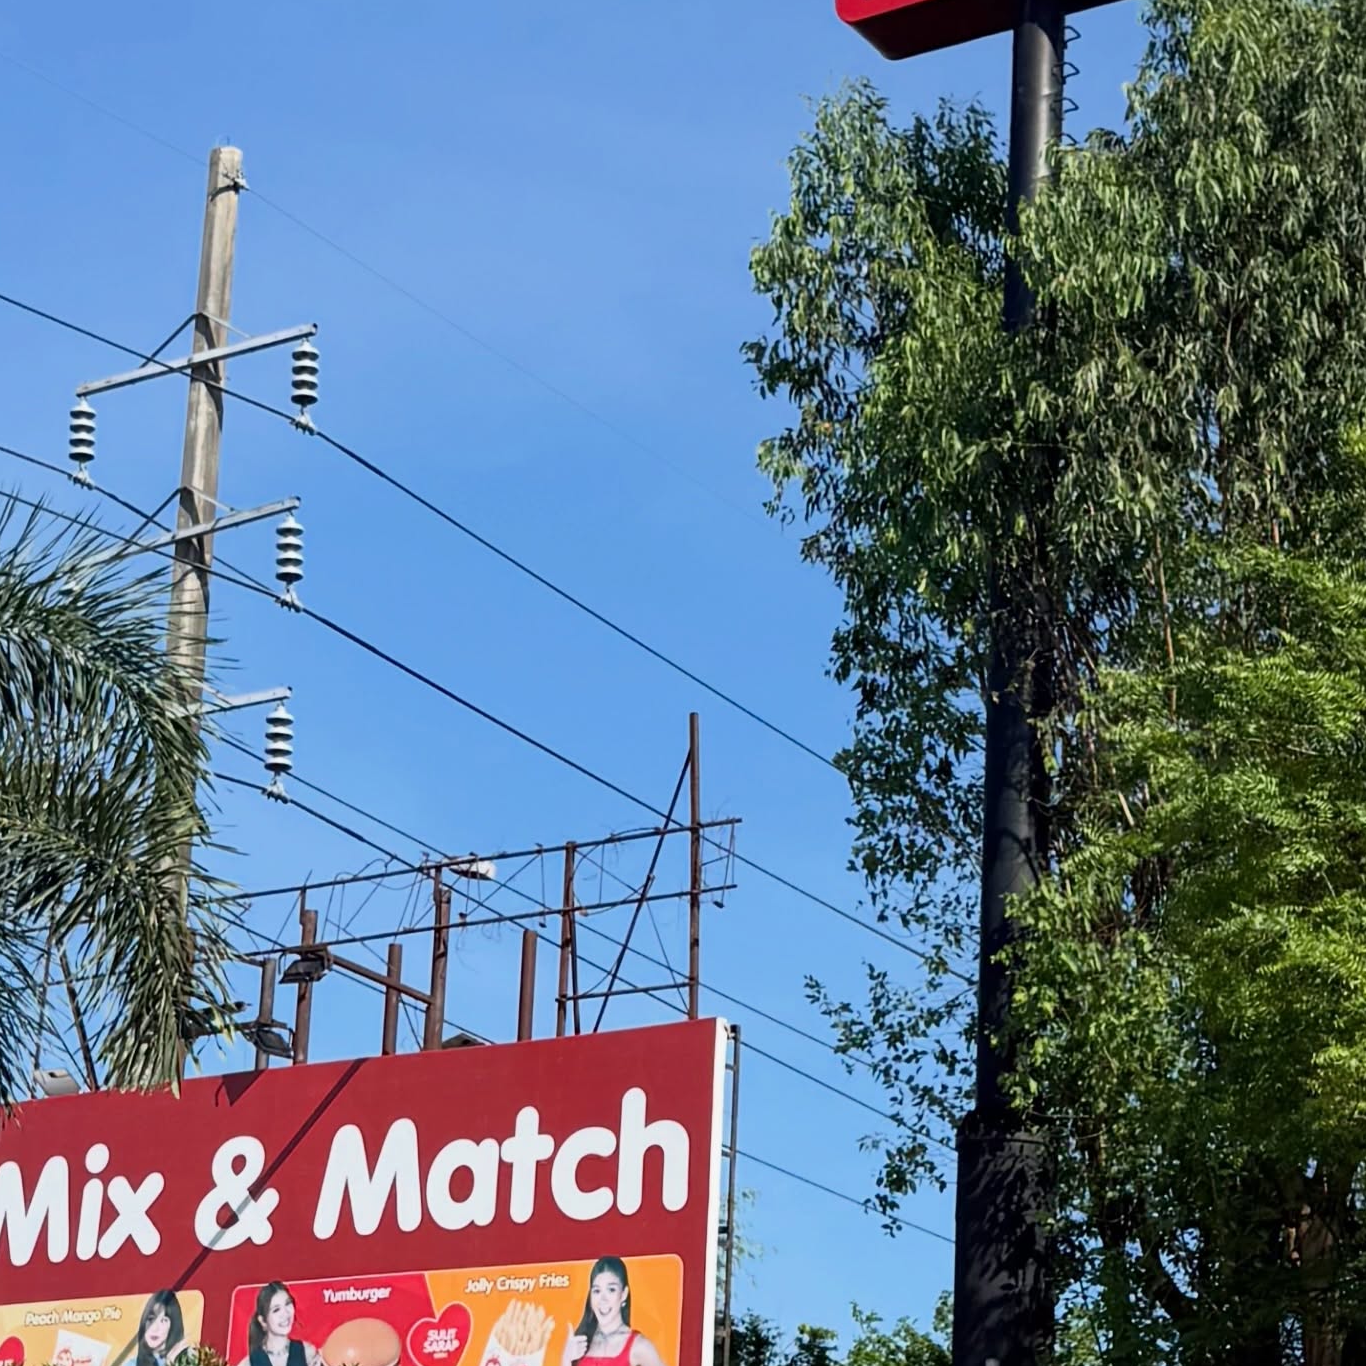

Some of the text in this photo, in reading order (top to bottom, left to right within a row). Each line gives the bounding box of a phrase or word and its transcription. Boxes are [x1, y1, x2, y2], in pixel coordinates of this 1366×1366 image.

[194, 1135, 280, 1252] &
[312, 1086, 691, 1241] Match
[464, 1273, 570, 1294] Jolly Crispy Fries
[322, 1286, 392, 1304] Yumburger
[25, 1304, 123, 1327] Peach Mango Pie
